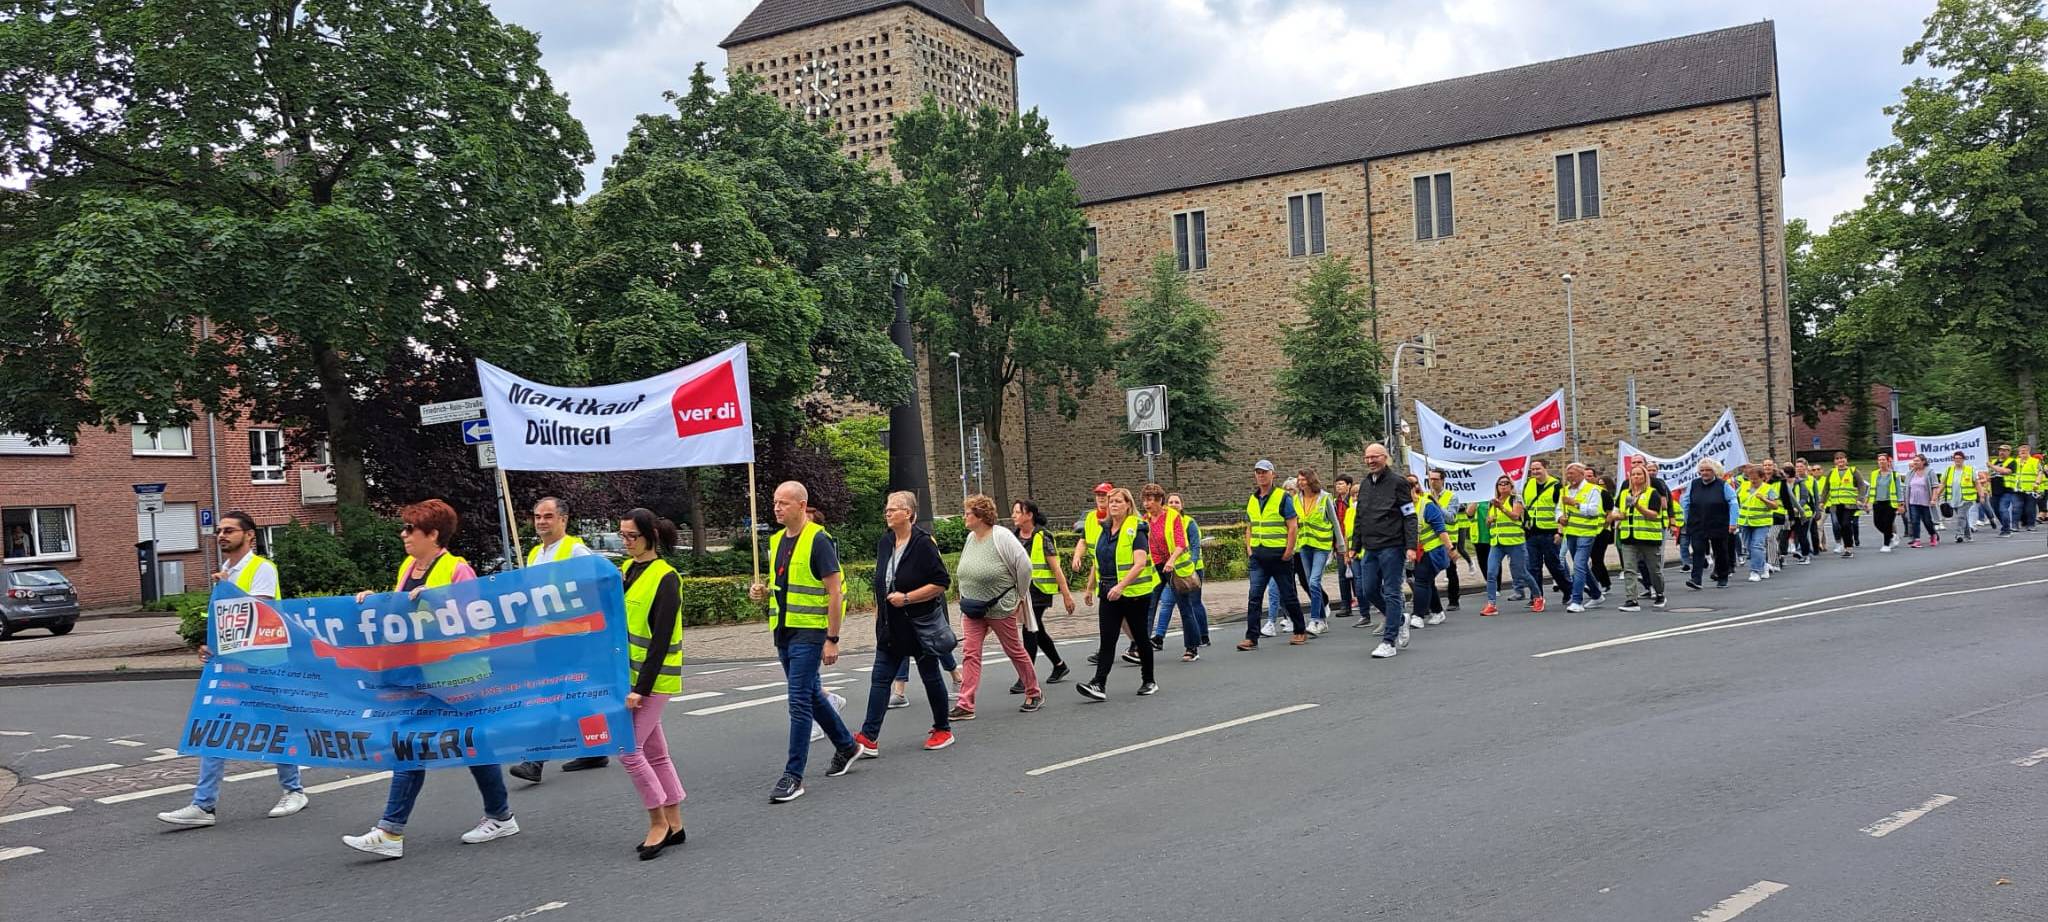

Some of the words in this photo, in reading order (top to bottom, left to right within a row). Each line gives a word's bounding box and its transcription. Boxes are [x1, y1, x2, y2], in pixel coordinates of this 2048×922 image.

[508, 382, 646, 416] Marktkauf
[1138, 398, 1151, 412] 30
[678, 402, 736, 422] ver.di
[525, 418, 611, 446] Dülmen
[1443, 422, 1508, 440] Kaufland
[1443, 435, 1496, 452] Borken
[1920, 438, 1980, 453] Marktkauf
[217, 602, 249, 616] OHNE
[358, 581, 585, 645] fordern:
[218, 613, 248, 629] UNS
[188, 712, 297, 756] WÜRDE.
[304, 728, 383, 762] WERT.
[391, 727, 477, 761] WIR!
